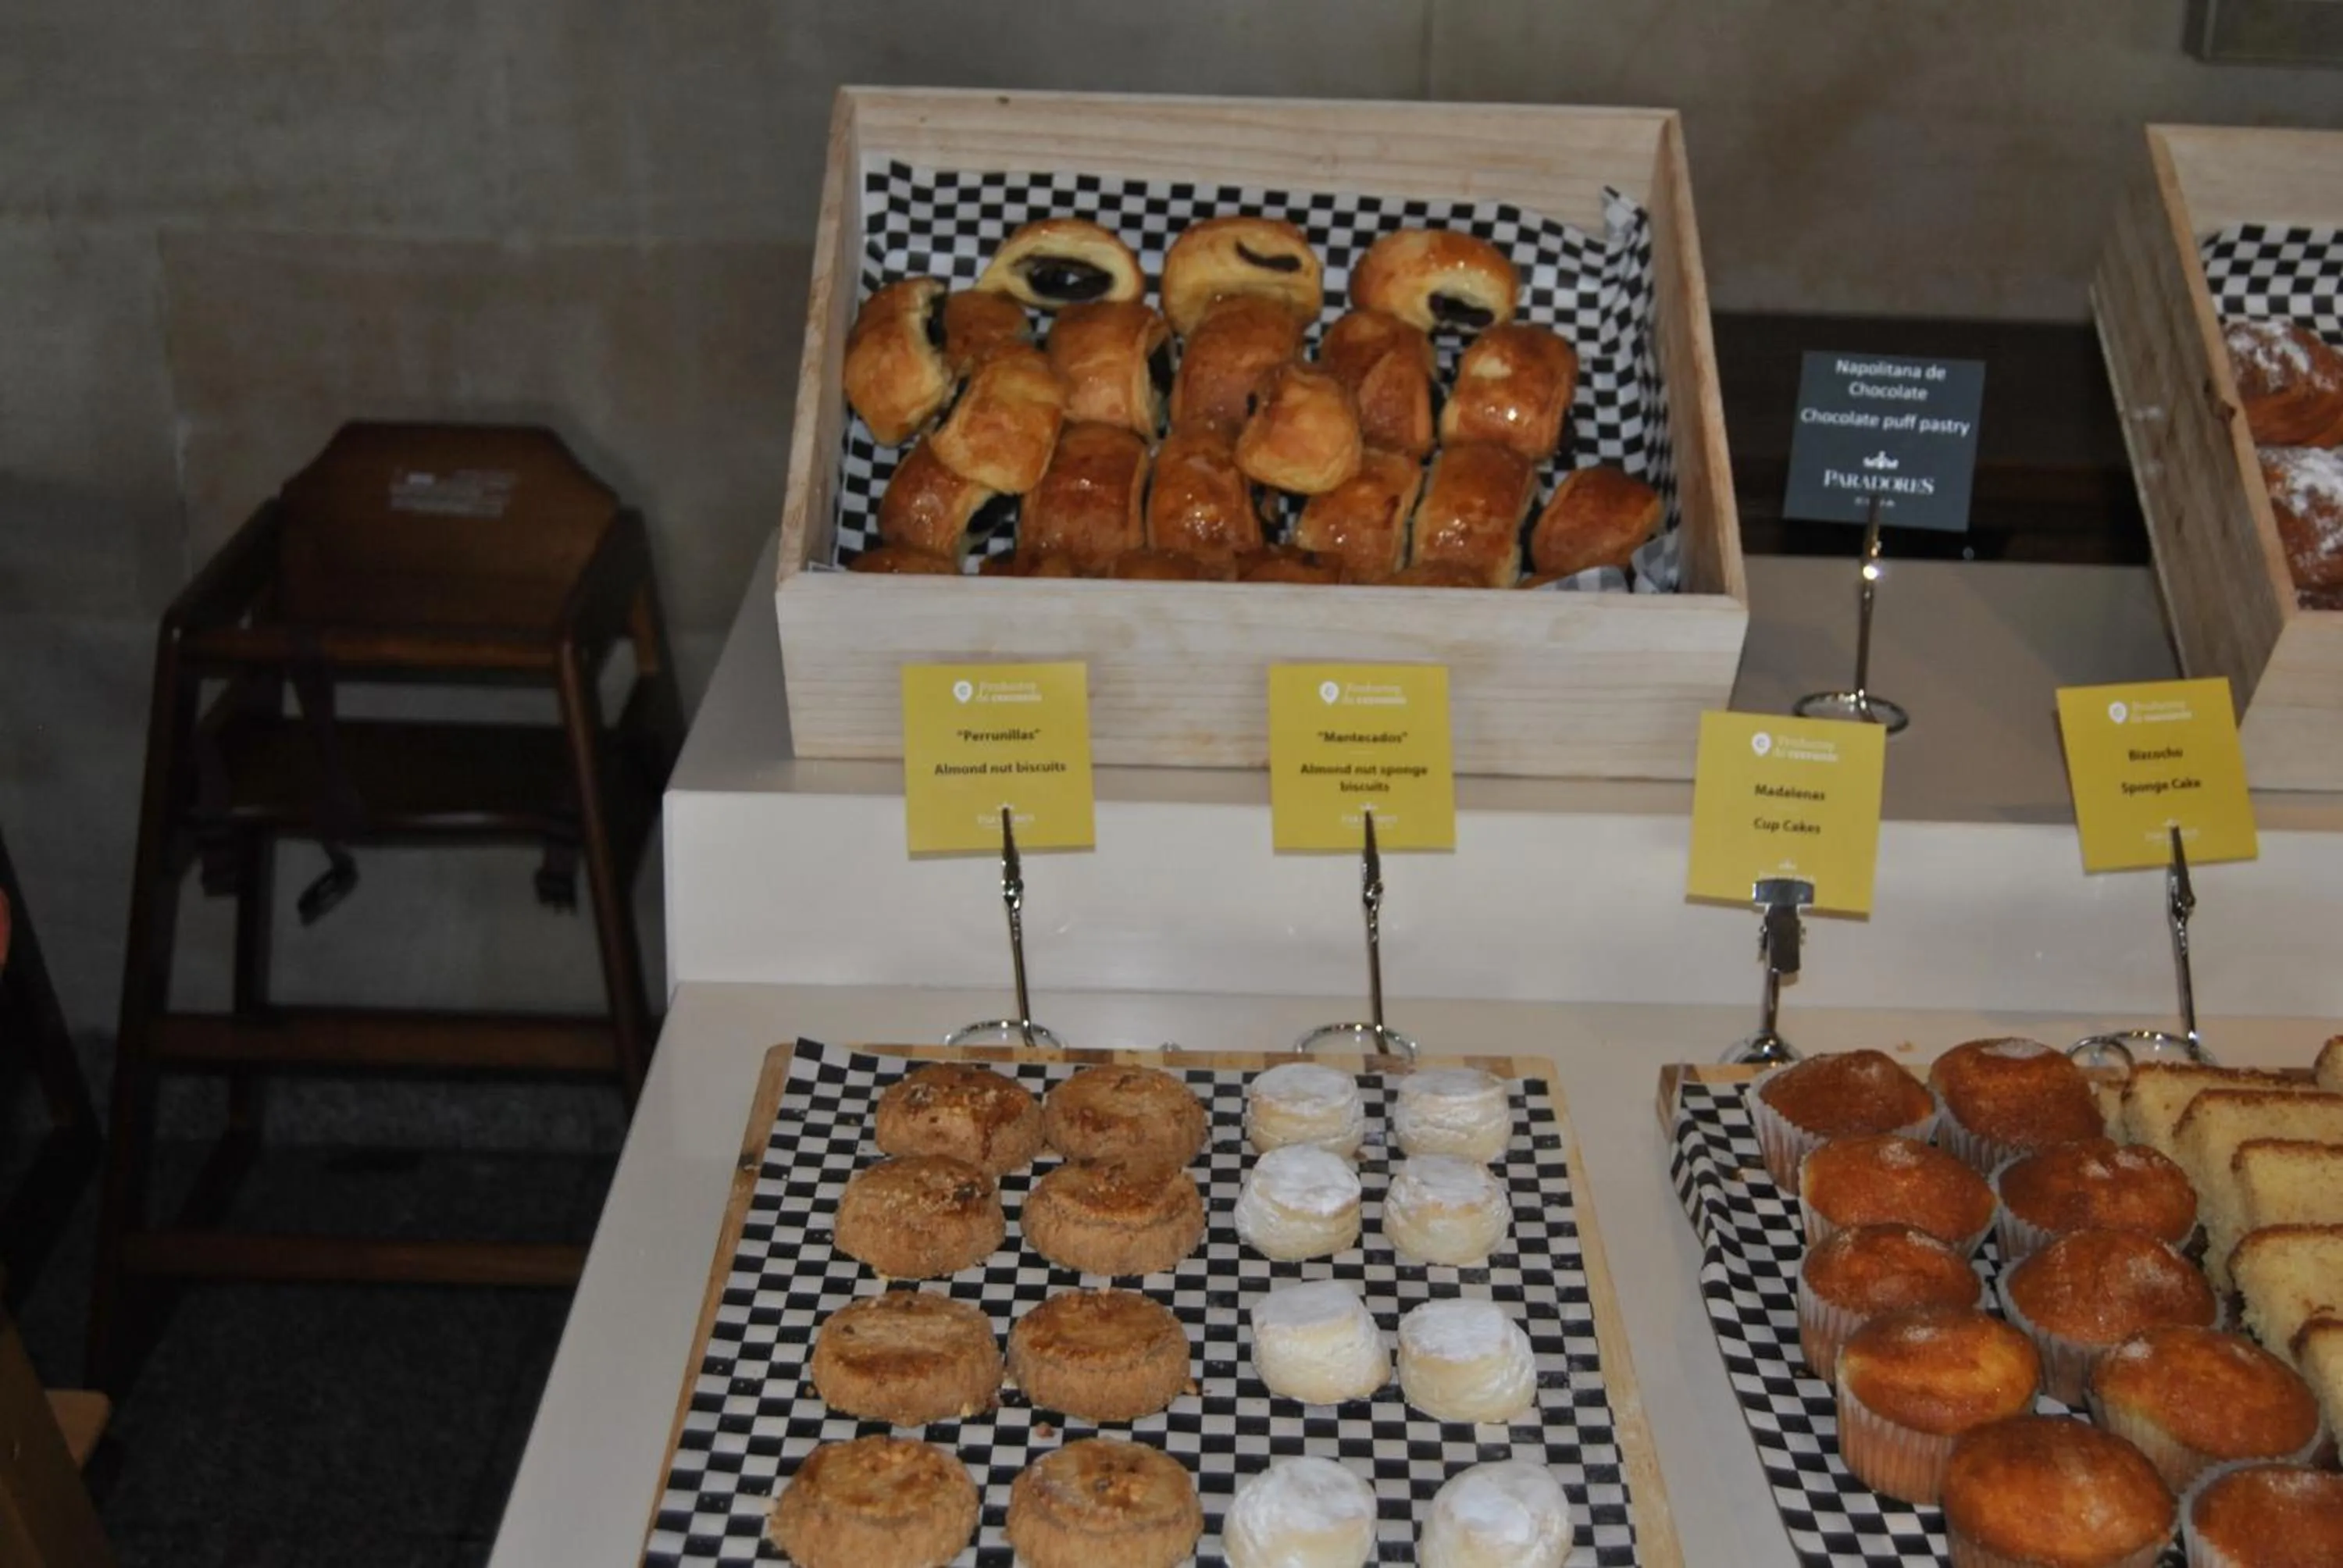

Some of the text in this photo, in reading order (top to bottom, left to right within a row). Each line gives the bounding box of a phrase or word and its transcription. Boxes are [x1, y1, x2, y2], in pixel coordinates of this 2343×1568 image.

[1835, 359, 1946, 380] Napolitana de
[1849, 382, 1928, 400] Chocolate
[1800, 408, 1970, 437] Chocolate puff pastry
[1824, 469, 1935, 494] PARADORES
[935, 761, 1067, 775] Almond nut biscuits
[1300, 764, 1428, 778] Almond nut sponge
[1340, 781, 1390, 793] biscuits
[2121, 778, 2202, 796] Sponge Cake
[1753, 818, 1822, 835] Cup Cakes
